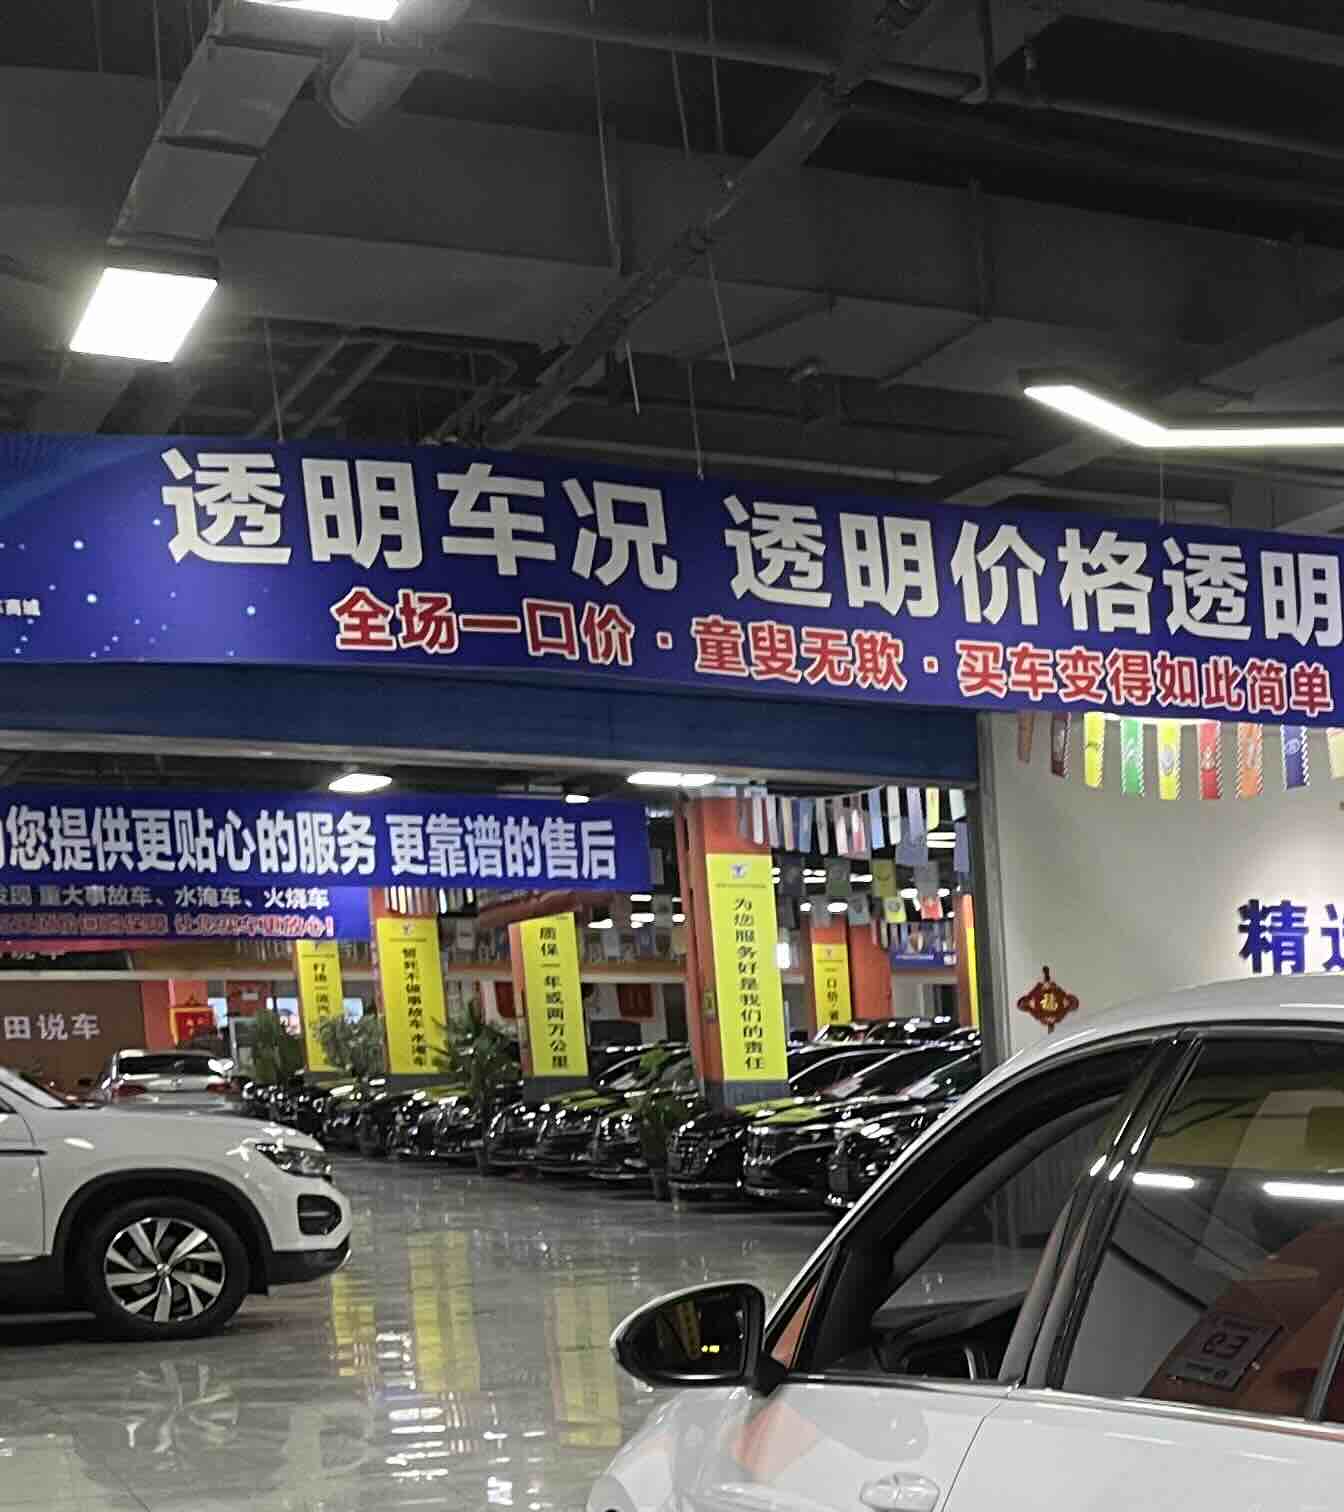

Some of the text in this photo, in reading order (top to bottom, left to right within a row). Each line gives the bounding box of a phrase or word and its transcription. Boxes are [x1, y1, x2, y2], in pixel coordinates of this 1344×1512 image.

[159, 447, 680, 592] 透明车况
[0, 805, 617, 883] 您提供更贴心的服务 更靠谱的售后
